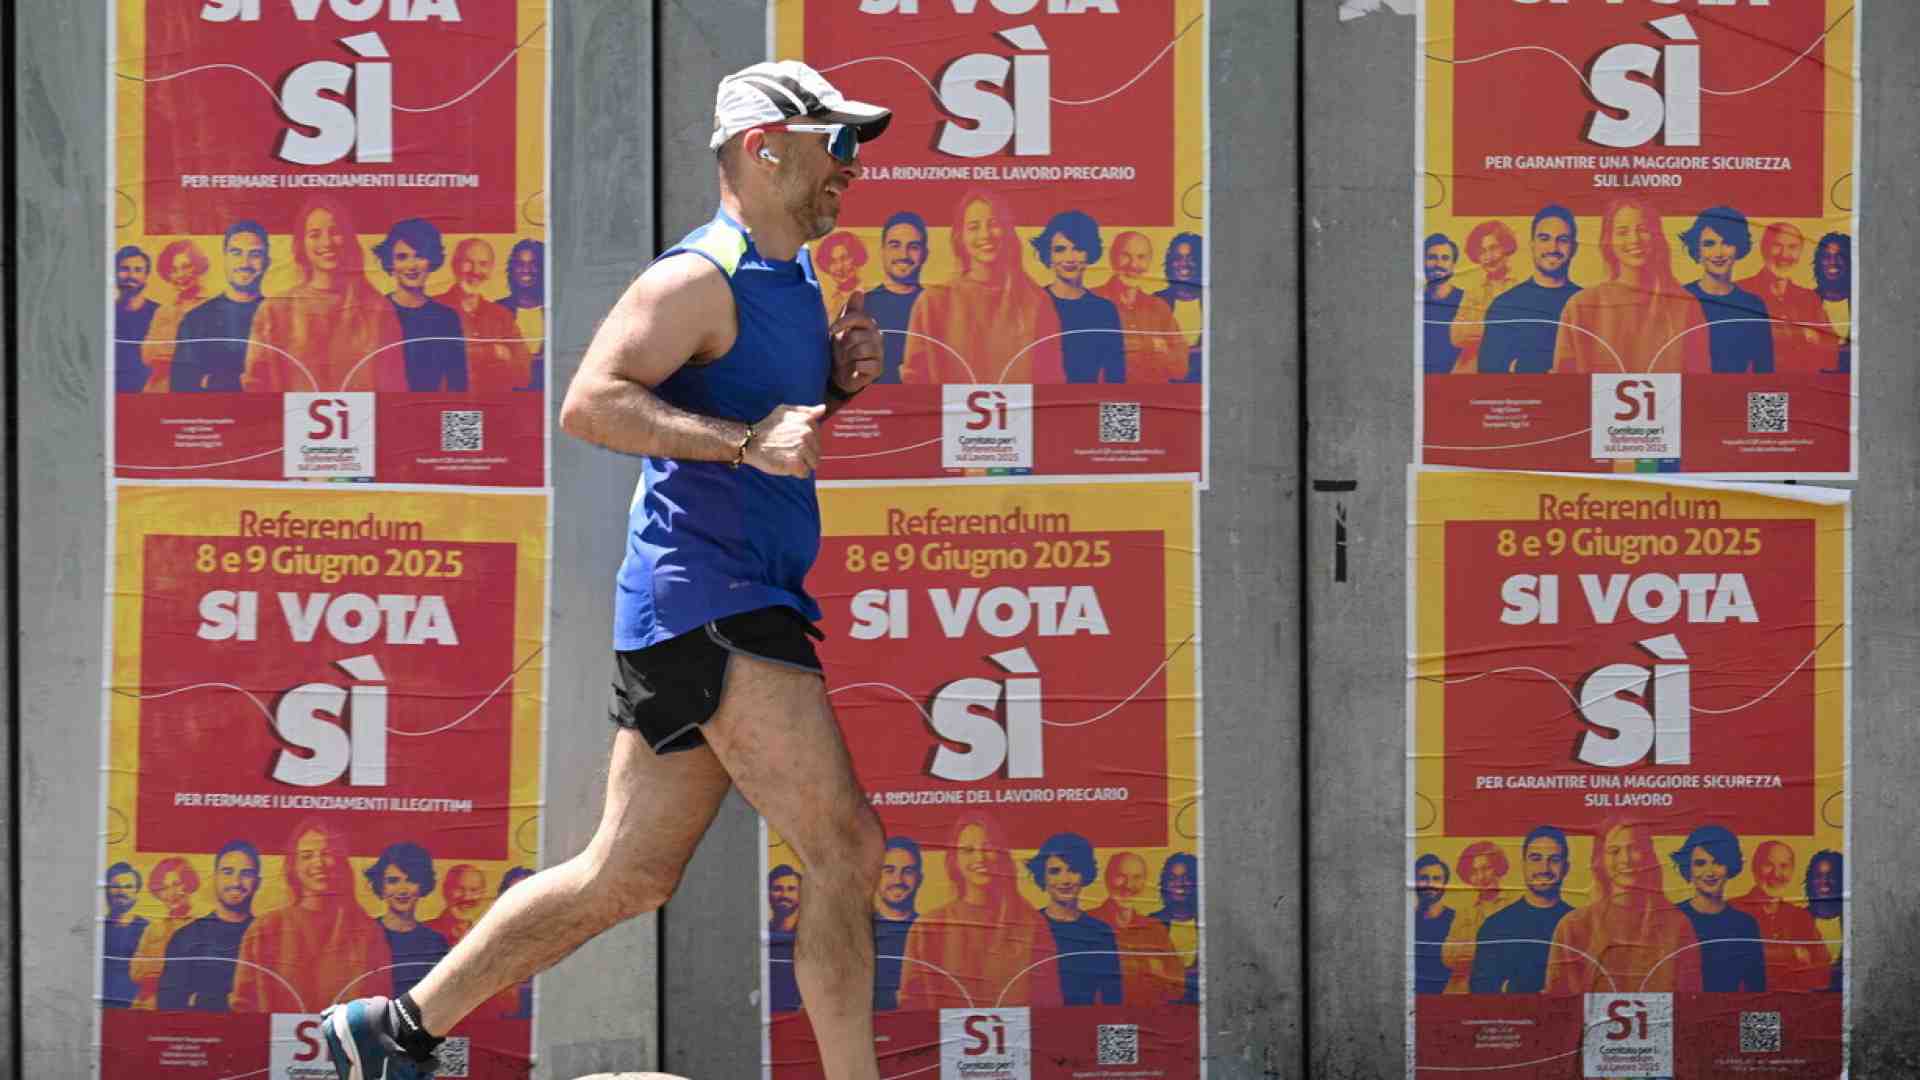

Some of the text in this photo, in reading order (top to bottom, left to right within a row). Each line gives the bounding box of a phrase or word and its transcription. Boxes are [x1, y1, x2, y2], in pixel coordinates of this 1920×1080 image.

[279, 32, 393, 165] SÌ
[938, 24, 1050, 158] SÌ
[1588, 14, 1700, 148] SÌ
[181, 174, 209, 187] PER
[211, 174, 280, 188] FERMARE
[288, 174, 394, 188] LICENZIAMENTI
[399, 174, 479, 188] ILLEGITTIMI
[872, 166, 891, 180] LA
[892, 166, 970, 180] RIDUZIONE
[974, 166, 1000, 180] DEL
[1003, 166, 1060, 180] LAVORO
[1063, 166, 1136, 181] PRECARIO
[1485, 156, 1791, 170] PER GARANTIRE UNA MAGGIORE SICUREZZA
[1593, 174, 1681, 187] SUL LAVORO
[308, 399, 350, 440] Sì
[966, 390, 1008, 430] Sì
[1615, 380, 1657, 422] Sì
[240, 510, 423, 540] Referendum
[887, 507, 1070, 535] Referendum
[1539, 493, 1720, 520] Referendum
[196, 544, 463, 583] 8 e 9 Giugno 2025
[846, 540, 1112, 578] 8 e 9 Giugno 2025
[1497, 527, 1762, 564] 8 e 9 Giugno 2025
[196, 590, 459, 645] SI VOTA
[849, 585, 1110, 640] SI VOTA
[1500, 573, 1760, 624] SI VOTA
[929, 647, 1044, 781] SÌ
[1576, 634, 1691, 767] SÌ
[270, 655, 388, 787] SÌ
[886, 791, 964, 805] RIDUZIONE
[967, 790, 992, 803] DEL
[996, 789, 1054, 803] LAVORO
[1057, 787, 1128, 801] PRECARIO
[1476, 774, 1781, 789] PER GARANTIRE UNA MAGGIORE SICUREZZA
[1584, 793, 1673, 807] SUL LAVORO
[175, 793, 202, 806] PER
[205, 794, 271, 808] FERMARE
[280, 796, 387, 811] LICENZIAMENTI
[391, 798, 473, 812] ILLEGITTIMI
[963, 1015, 1006, 1056] Sì
[1606, 1000, 1649, 1040] Sì
[293, 1021, 333, 1062] S
